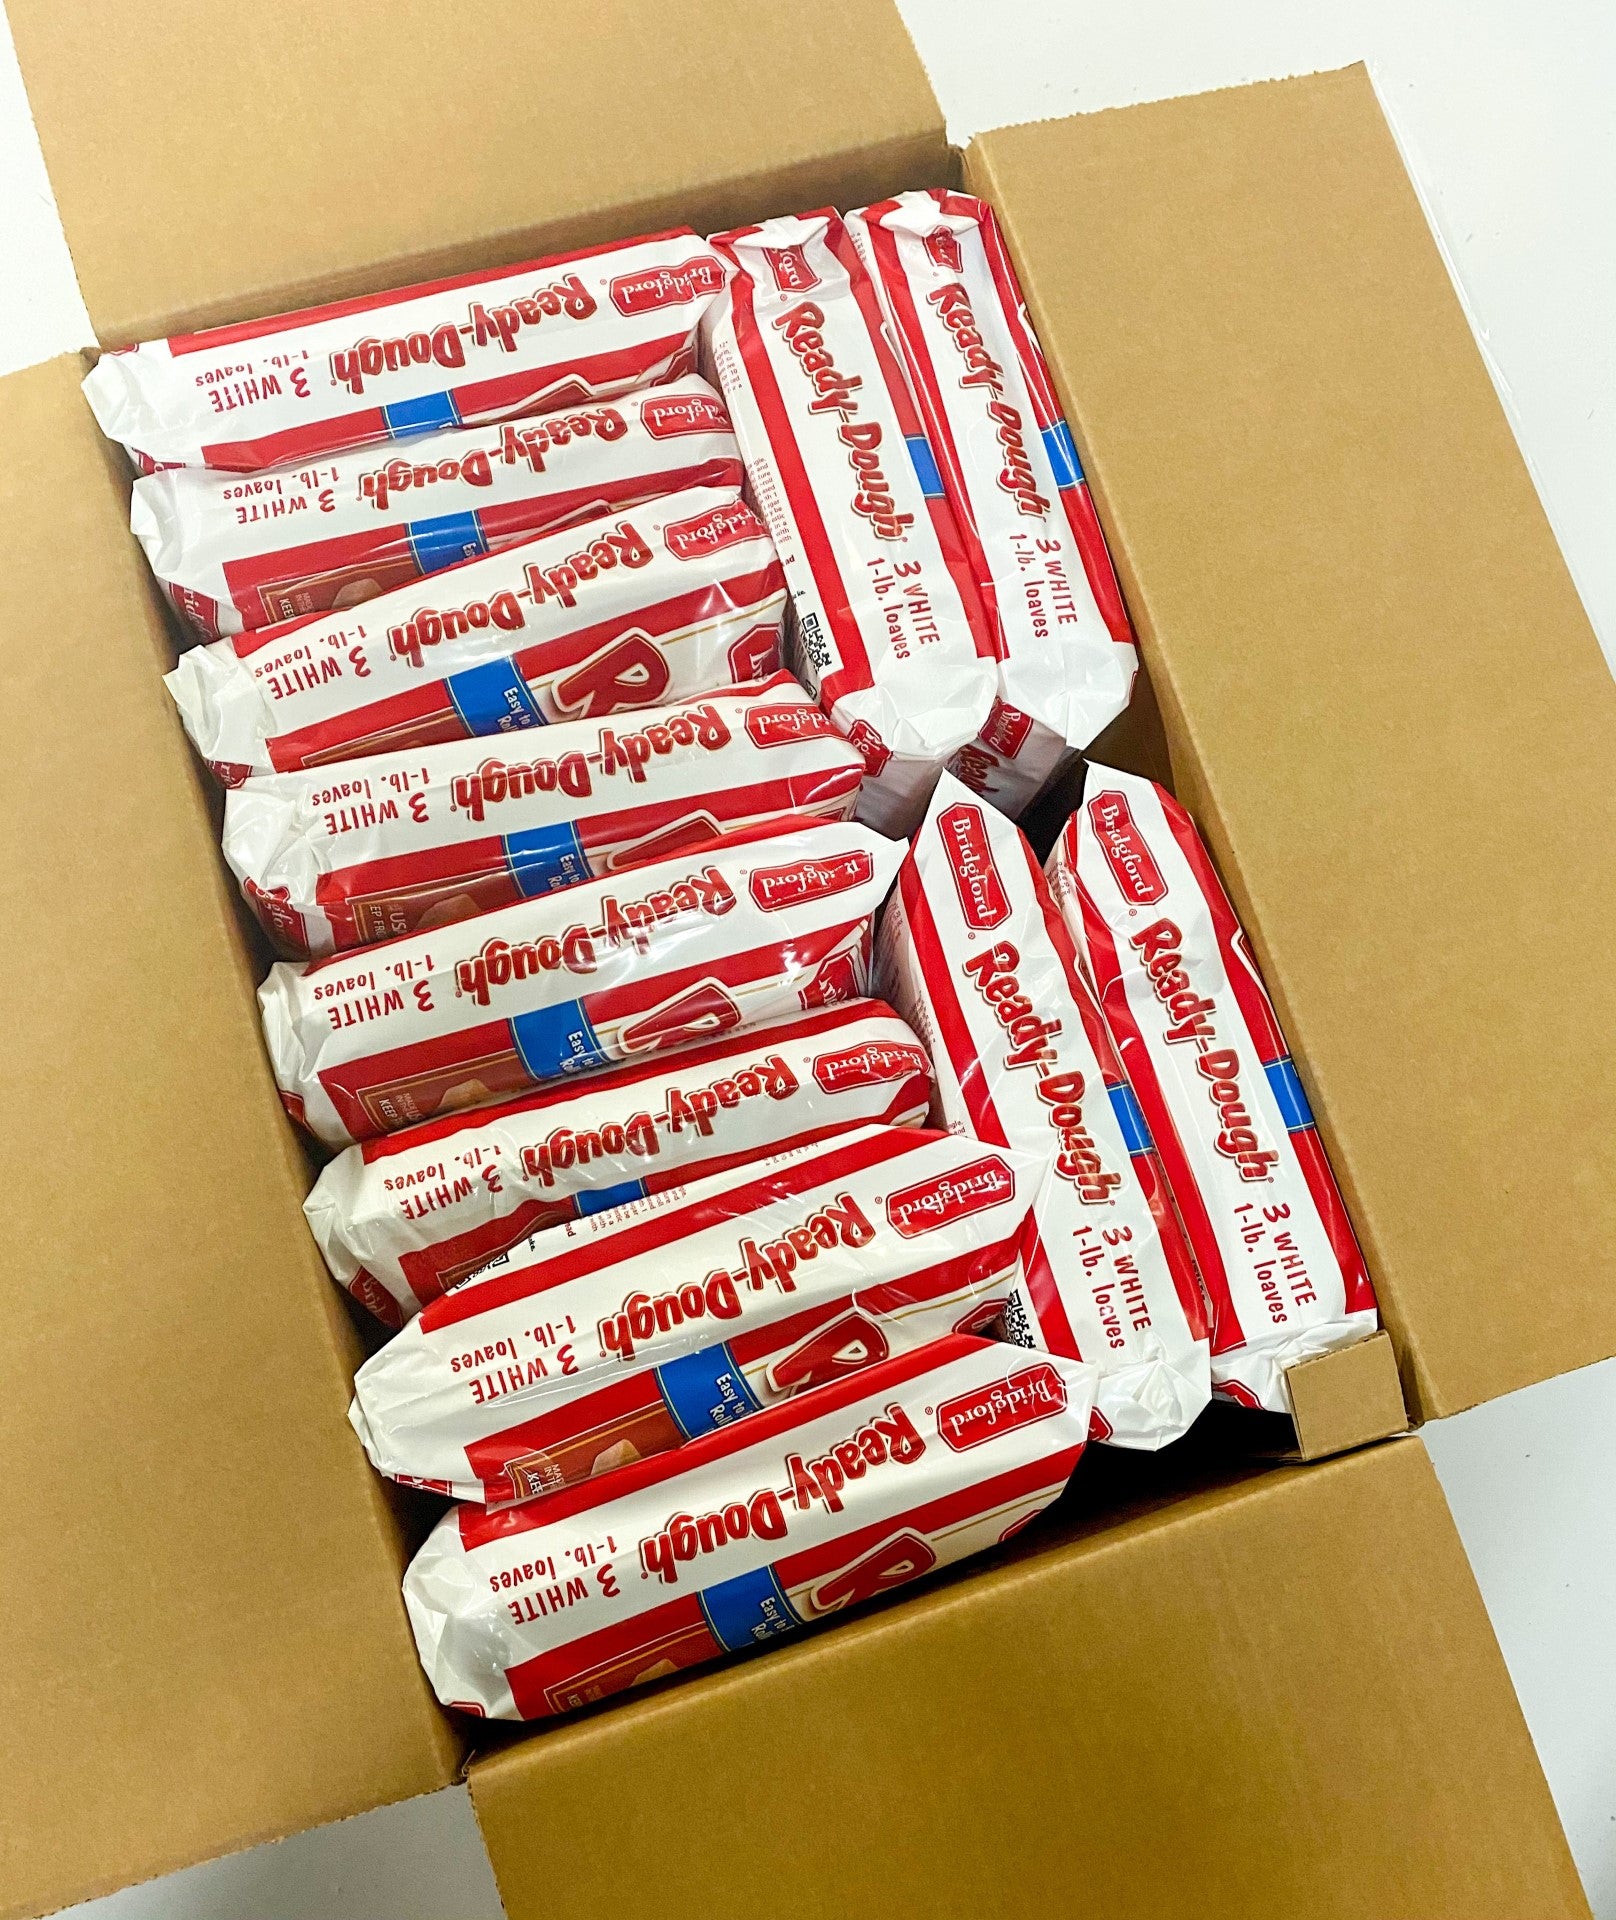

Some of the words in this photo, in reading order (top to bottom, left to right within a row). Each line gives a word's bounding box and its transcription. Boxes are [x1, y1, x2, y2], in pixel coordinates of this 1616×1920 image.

[621, 267, 713, 303] Bridgford
[329, 275, 597, 395] Ready-Dough
[195, 363, 253, 386] loaves
[263, 350, 310, 368] 1-lb.
[209, 375, 282, 413] WHITE
[290, 367, 311, 398] 3
[773, 301, 907, 542] Ready-Dough
[358, 405, 627, 510] Ready-Dough
[223, 477, 282, 503] loaves
[291, 466, 339, 489] 1-lb.
[236, 494, 307, 524] WHITE
[317, 489, 336, 511] 3
[1036, 538, 1061, 554] 3
[389, 521, 653, 668] Ready-Dough
[867, 557, 884, 603] 1-lb.
[882, 603, 909, 659] loaves
[894, 561, 919, 579] 3
[907, 589, 940, 646] WHITE
[1023, 583, 1048, 640] loaves
[1047, 563, 1077, 625] WHITE
[320, 625, 367, 652] 1-lb.
[253, 645, 312, 680] loaves
[266, 652, 341, 699] WHITE
[349, 646, 371, 677] 3
[504, 687, 524, 715] Easy
[380, 765, 430, 790] 1-lb.
[450, 704, 731, 822] Ready-Dough
[312, 779, 371, 809] loaves
[408, 795, 430, 823] 3
[324, 799, 398, 835] WHITE
[560, 854, 576, 876] Easy
[951, 818, 999, 921] Bridgford
[1102, 803, 1154, 900] Bridgford
[456, 867, 736, 1006] Ready-Dough
[313, 969, 376, 1004] loaves
[385, 955, 435, 983] 1-lb.
[327, 991, 405, 1031] WHITE
[414, 983, 435, 1012] 3
[567, 1031, 586, 1058] Easy
[1131, 918, 1275, 1184] Ready-Dough
[825, 1047, 923, 1080] Bridgford
[964, 940, 1124, 1208] Ready-Dough
[520, 1054, 799, 1193] Ready-Dough
[454, 1144, 502, 1171] 1-lb.
[383, 1163, 445, 1195] loaves
[484, 1167, 503, 1193] 3
[400, 1177, 473, 1220] WHITE
[895, 1170, 1001, 1225] Bridgford
[1262, 1202, 1291, 1225] 3
[1102, 1225, 1133, 1247] 3
[596, 1191, 876, 1361] Ready-Dough
[1234, 1203, 1261, 1256] 1-lb.
[1255, 1259, 1288, 1325] loaves
[1274, 1232, 1317, 1306] WHITE
[1071, 1225, 1094, 1277] 1-lb.
[1095, 1285, 1126, 1349] loaves
[1115, 1256, 1152, 1333] WHITE
[525, 1315, 576, 1345] 1-lb.
[451, 1336, 517, 1375] loaves
[555, 1345, 579, 1377] 3
[467, 1357, 548, 1405] WHITE
[716, 1373, 738, 1404] Easy
[948, 1378, 1052, 1436] Bridgford
[640, 1402, 925, 1584] Ready-Dough
[565, 1536, 617, 1568] 1-lb.
[489, 1556, 556, 1594] loaves
[596, 1566, 620, 1597] 3
[507, 1577, 589, 1624] WHITE
[760, 1597, 780, 1622] Easy
